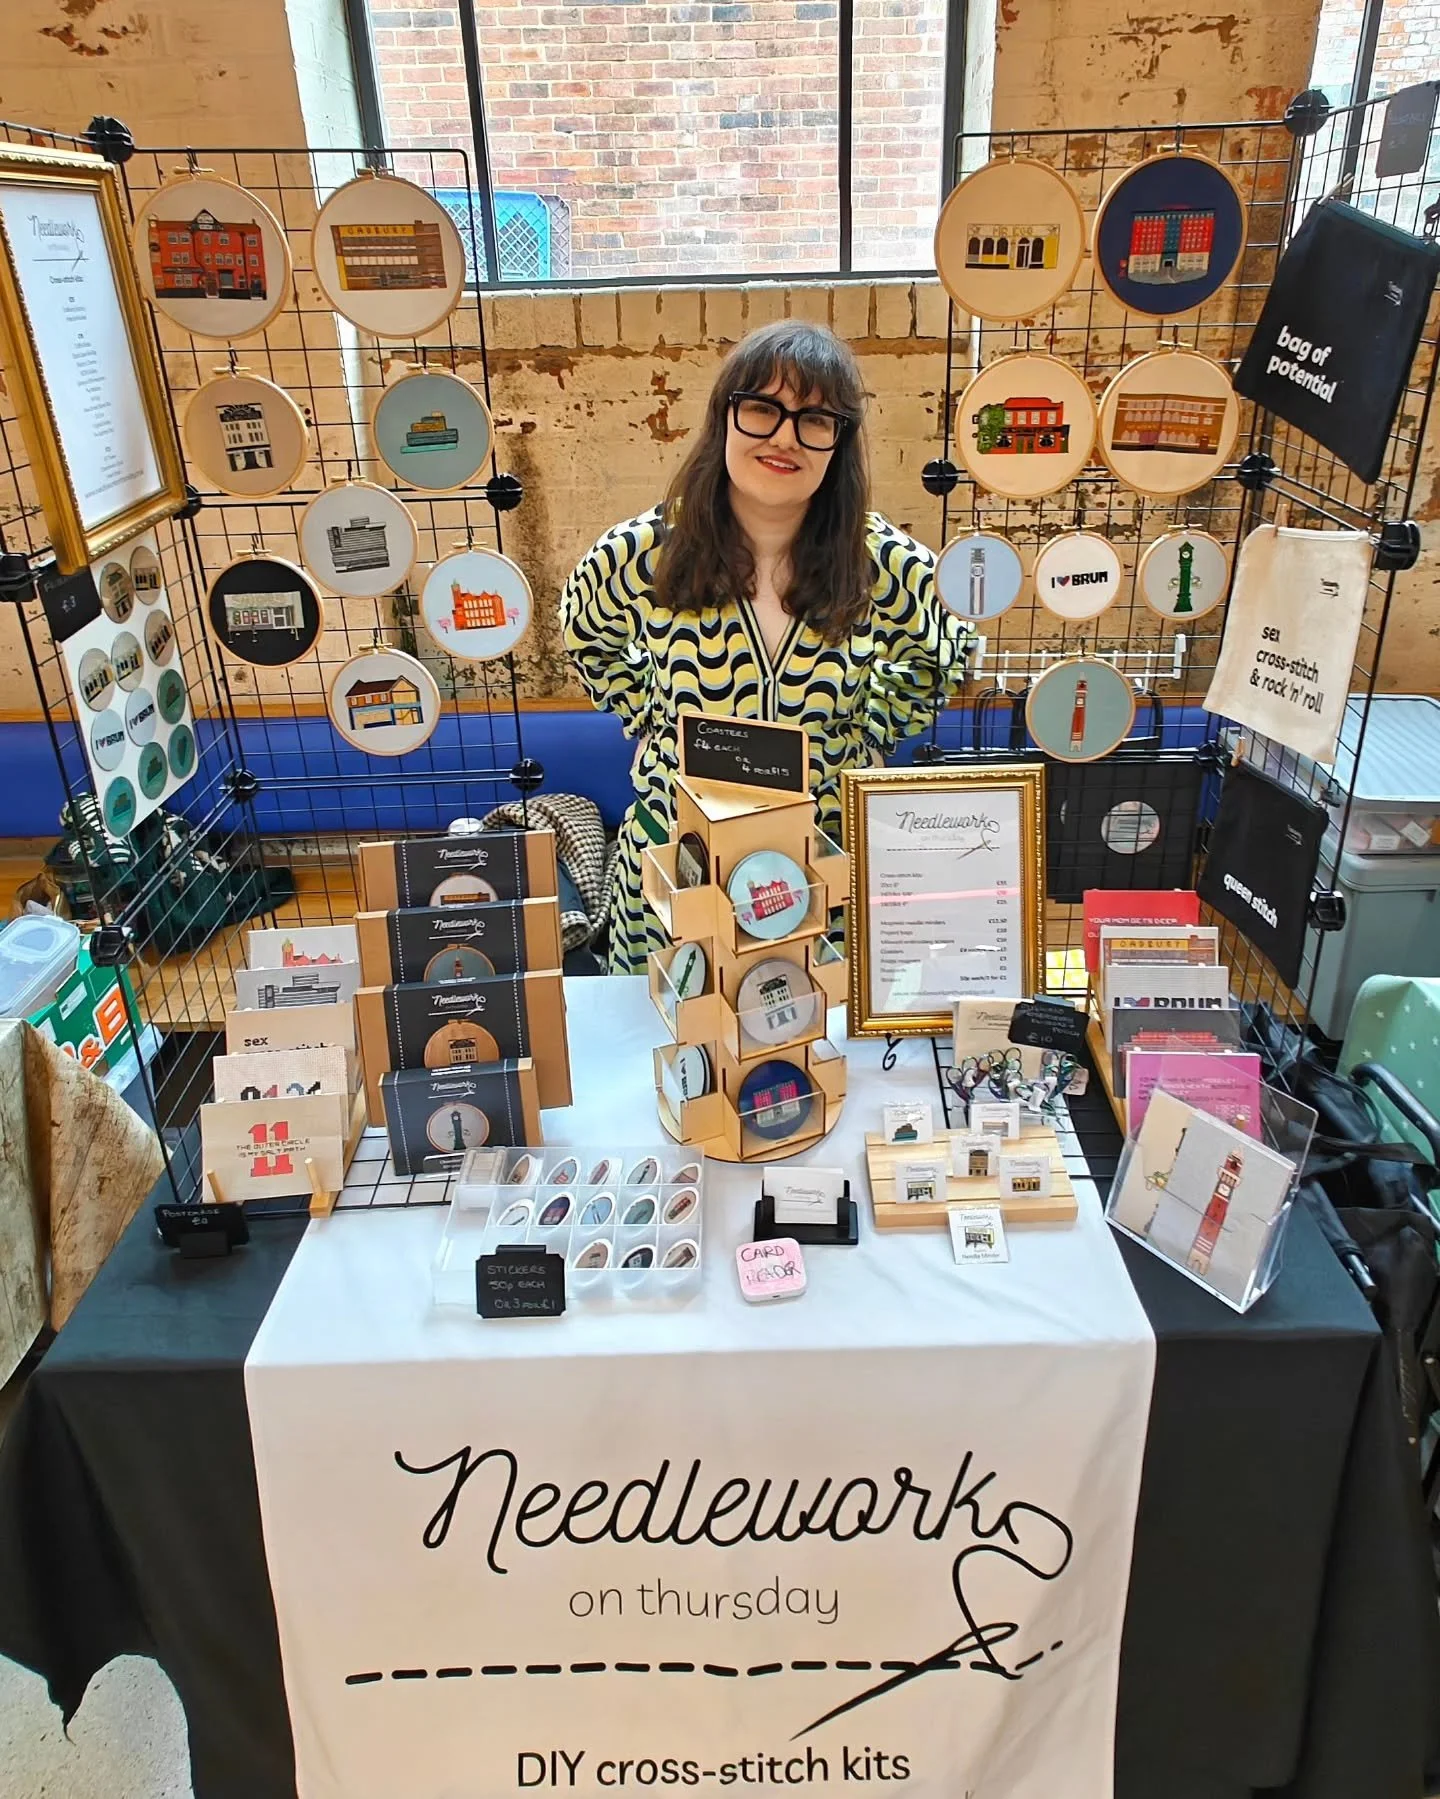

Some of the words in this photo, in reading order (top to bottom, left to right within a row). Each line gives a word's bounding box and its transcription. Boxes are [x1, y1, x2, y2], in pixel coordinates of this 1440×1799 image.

[1276, 325, 1312, 361] bag
[1311, 346, 1332, 367] of
[1266, 354, 1338, 404] potential
[1072, 571, 1108, 586] BRUM
[1261, 626, 1281, 643] sex
[1256, 649, 1319, 684] cross-stitch
[1250, 668, 1260, 687] &
[1262, 677, 1288, 699] rock
[1302, 691, 1325, 715] roll
[696, 721, 749, 738] COASTERS
[693, 738, 711, 750] £4
[895, 811, 989, 833] Needlework
[1223, 873, 1253, 904] queen
[1250, 896, 1278, 929] stitch
[244, 1036, 269, 1047] sex
[740, 1245, 785, 1262] CARD
[487, 1264, 546, 1275] STICKERS
[488, 1280, 513, 1292] 50p
[517, 1280, 546, 1288] EACH
[395, 1445, 1005, 1574] Needlework
[569, 1583, 624, 1618] on
[639, 1576, 840, 1625] thursday
[518, 1751, 585, 1788] DIY
[597, 1745, 830, 1786] cross-stitch
[841, 1743, 911, 1783] kits
